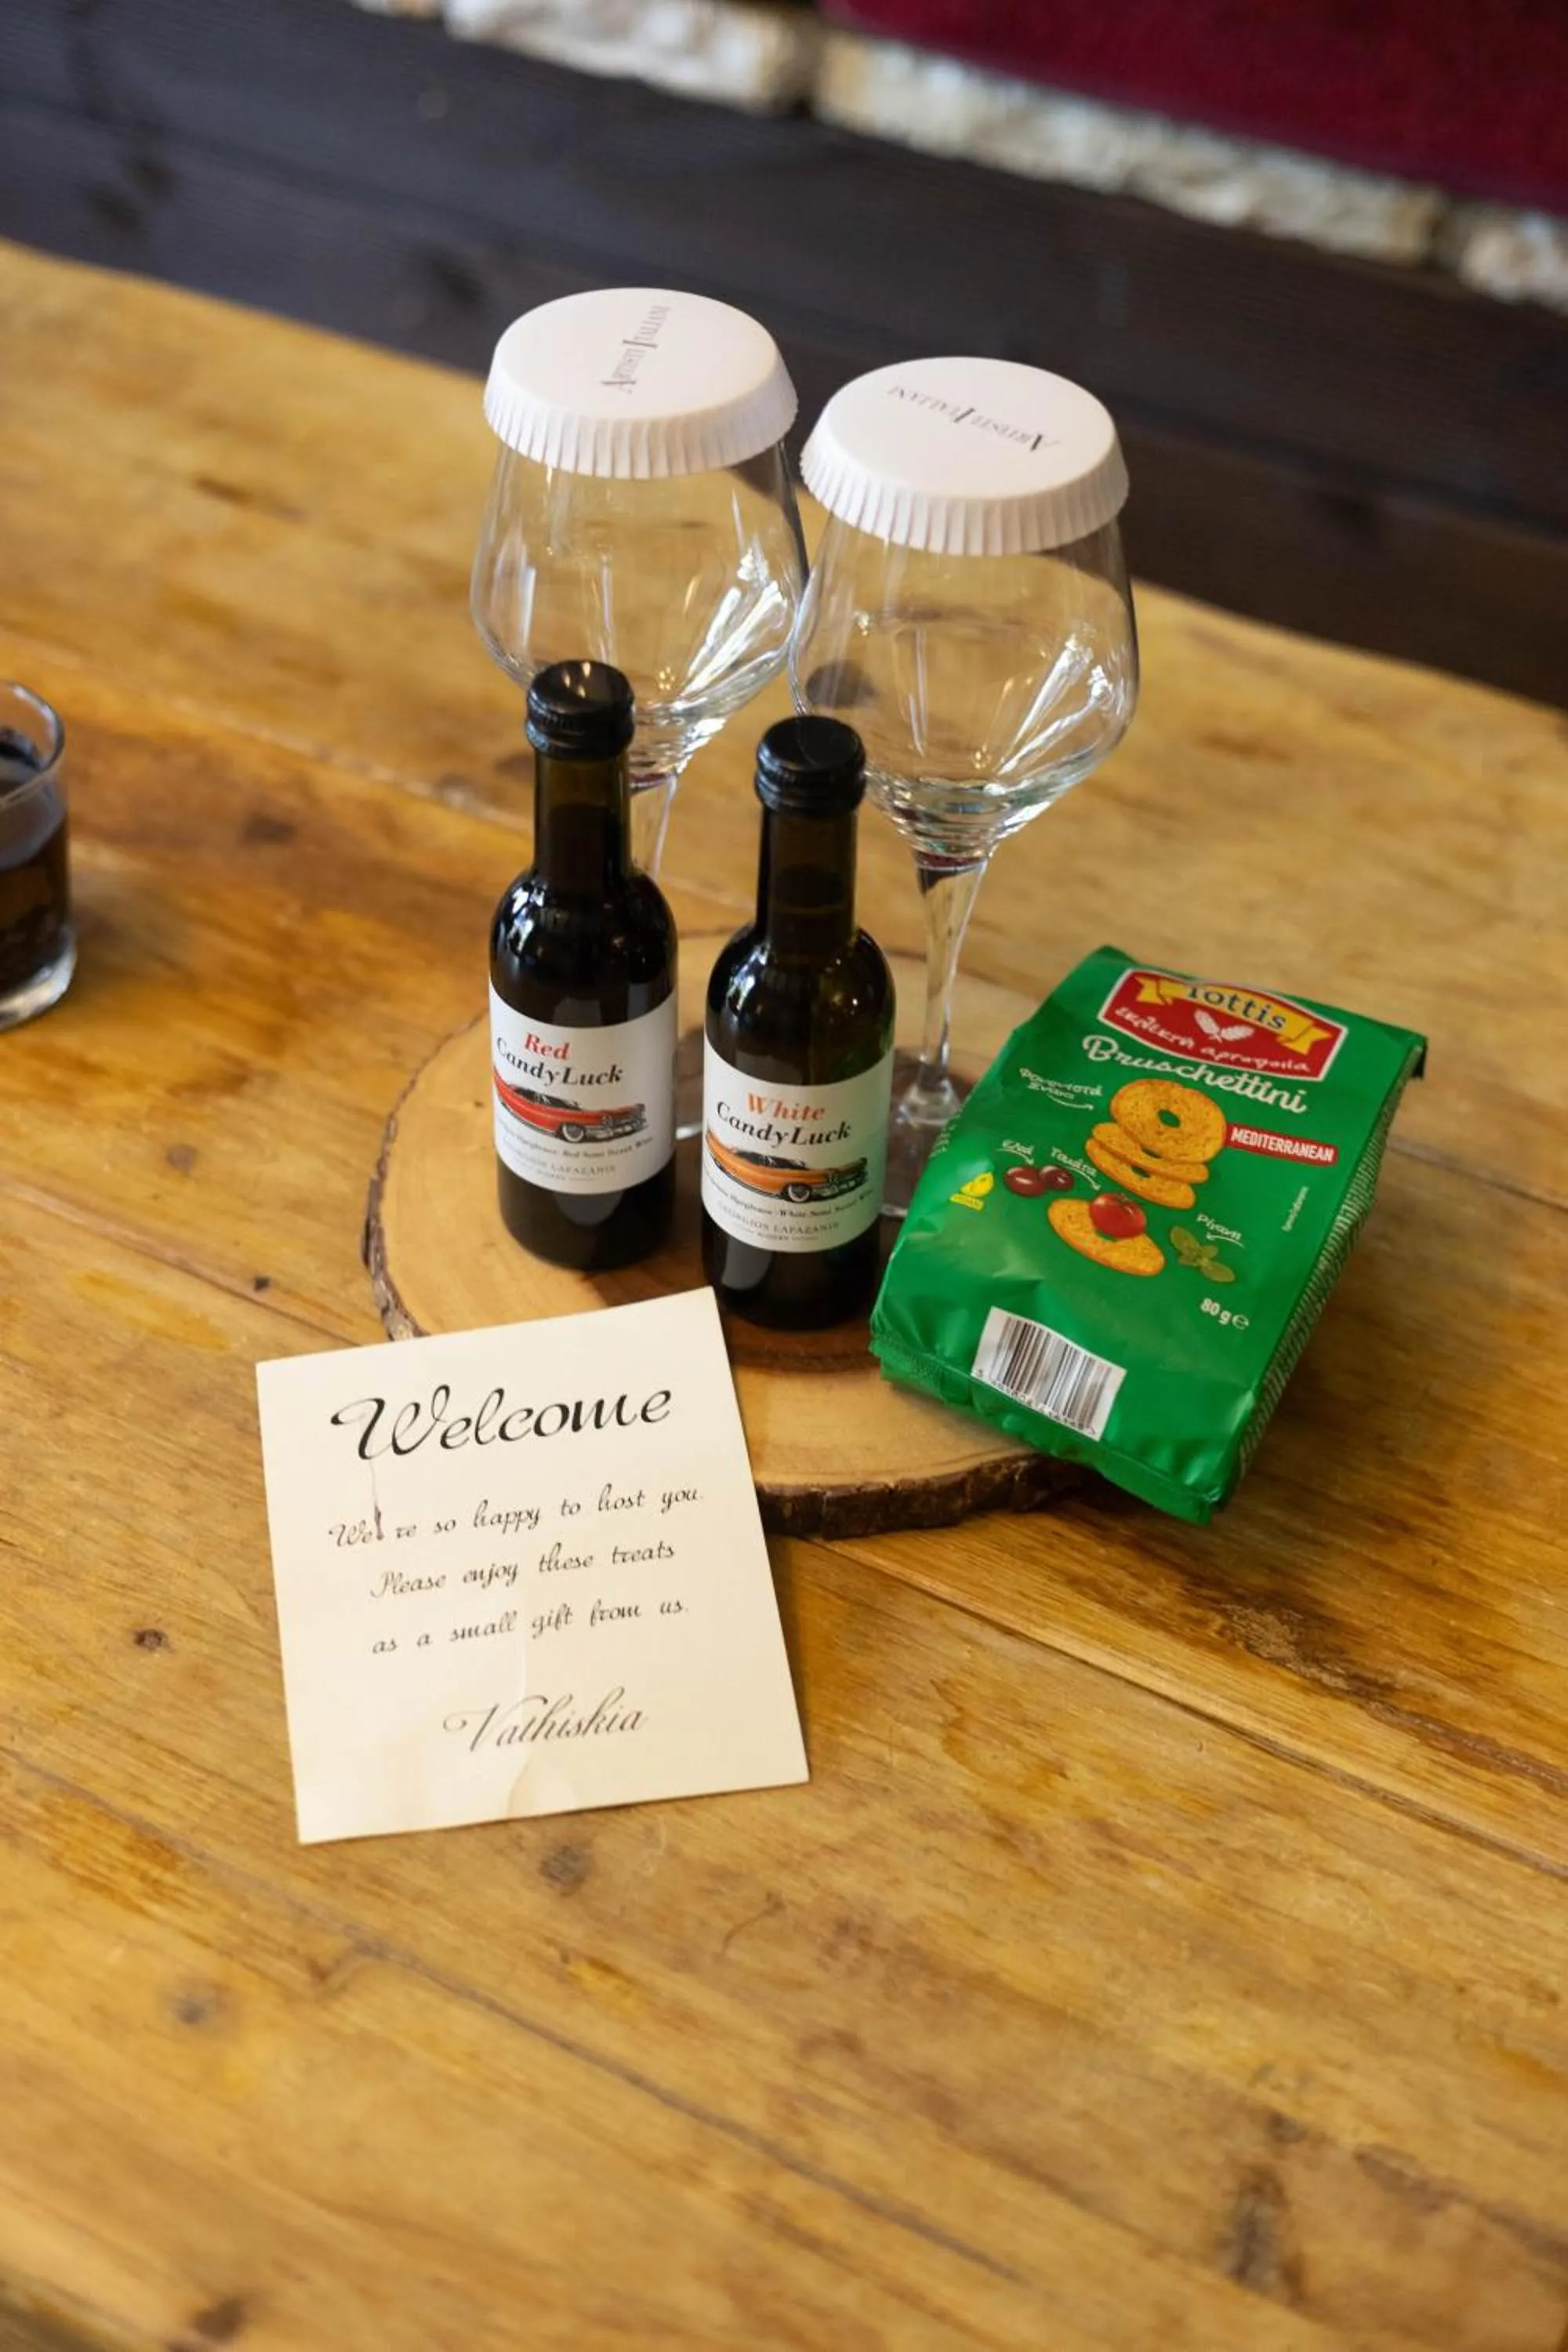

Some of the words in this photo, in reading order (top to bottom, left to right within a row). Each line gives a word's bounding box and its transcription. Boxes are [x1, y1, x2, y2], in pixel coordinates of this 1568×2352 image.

[524, 1032, 572, 1061] Red
[1082, 1033, 1308, 1115] Bruschettini
[746, 1093, 826, 1122] White
[1230, 1127, 1335, 1163] MEDITERRANEAN
[1200, 1298, 1221, 1316] 80
[330, 1384, 672, 1461] Welcome
[433, 1519, 456, 1534] so
[473, 1498, 540, 1534] happy
[561, 1498, 581, 1517] to
[597, 1483, 645, 1512] host
[370, 1570, 446, 1599] Please
[463, 1563, 519, 1589] enjoy
[539, 1542, 593, 1573] these
[612, 1541, 675, 1565] treats
[372, 1639, 397, 1654] as
[416, 1633, 430, 1647] a
[450, 1610, 517, 1642] small
[532, 1602, 573, 1640] gift
[590, 1599, 643, 1628] from
[442, 1686, 647, 1751] Vathiskia
